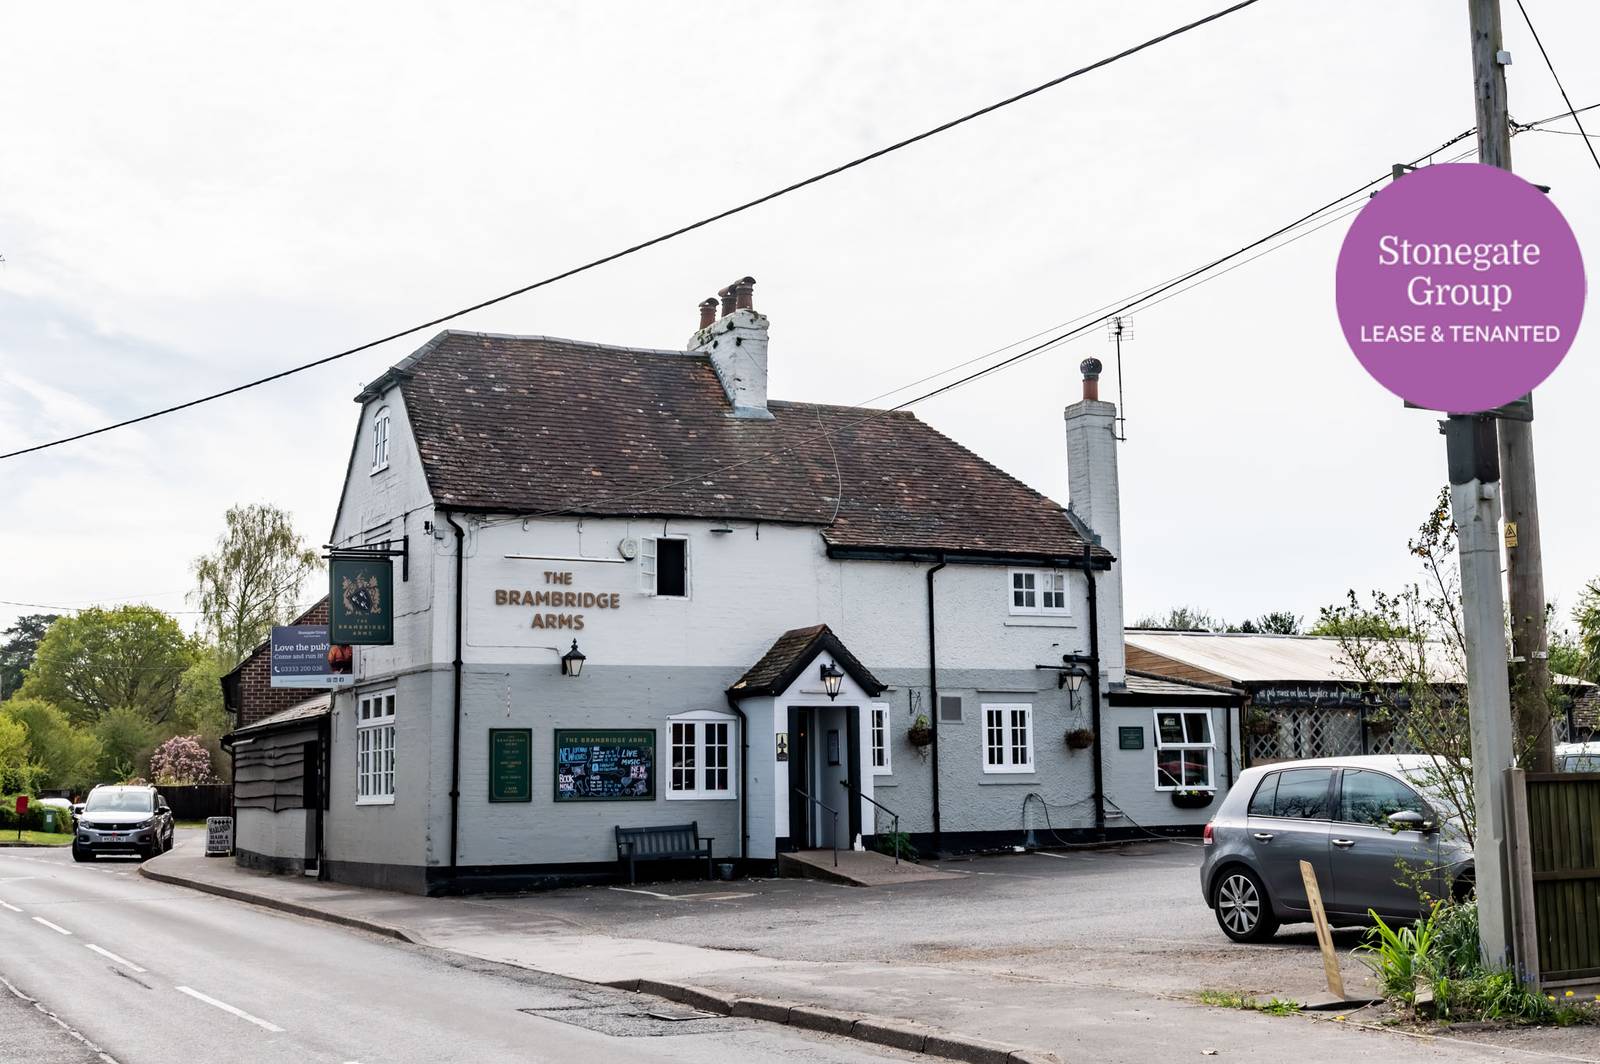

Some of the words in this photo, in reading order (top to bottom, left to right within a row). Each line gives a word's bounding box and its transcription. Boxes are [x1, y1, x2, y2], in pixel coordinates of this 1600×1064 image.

[544, 571, 573, 585] THE
[495, 589, 620, 609] BRAMBRIDGE
[531, 613, 584, 630] ARMS
[296, 643, 310, 651] the
[310, 643, 330, 652] pub?
[621, 749, 638, 758] LIVE
[559, 774, 575, 783] BOOK
